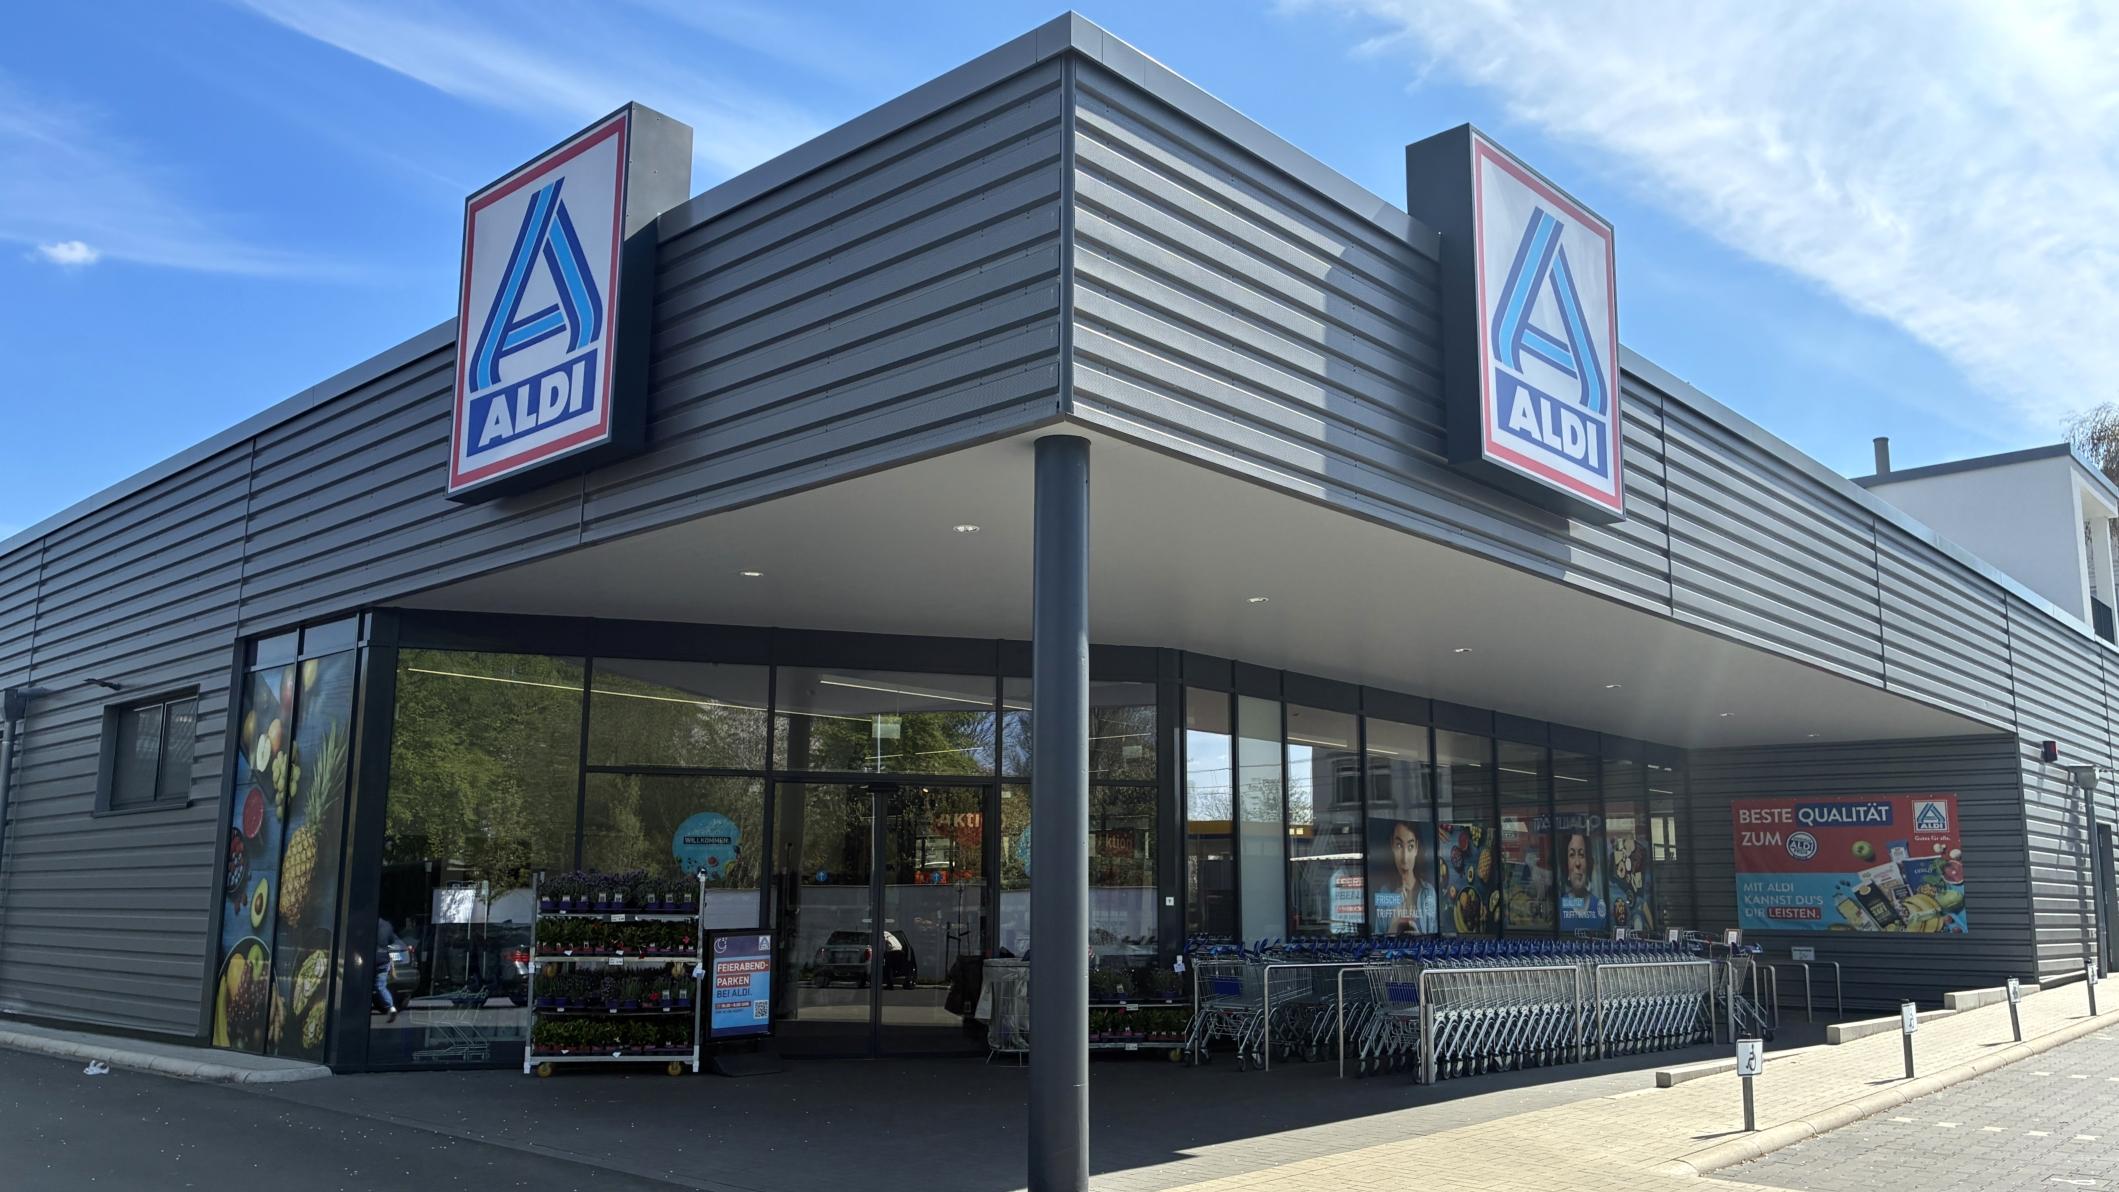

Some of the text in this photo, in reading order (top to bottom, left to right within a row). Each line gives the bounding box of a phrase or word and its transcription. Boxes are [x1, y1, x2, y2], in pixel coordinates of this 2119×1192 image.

[478, 361, 586, 447] ALDI
[1508, 386, 1599, 469] ALDI
[1739, 802, 1889, 826] BESTE QUALITÄT
[1741, 832, 1814, 852] ZUM ALDI
[1744, 882, 1794, 893] MIT ALDI
[1375, 895, 1401, 904] FRISCHE
[1744, 894, 1824, 905] KANNST DU'S
[1745, 907, 1820, 919] DIR LEISTEN.
[717, 961, 769, 973] FEIERABEND-
[717, 976, 750, 987] PARKEN
[717, 989, 730, 998] BEI
